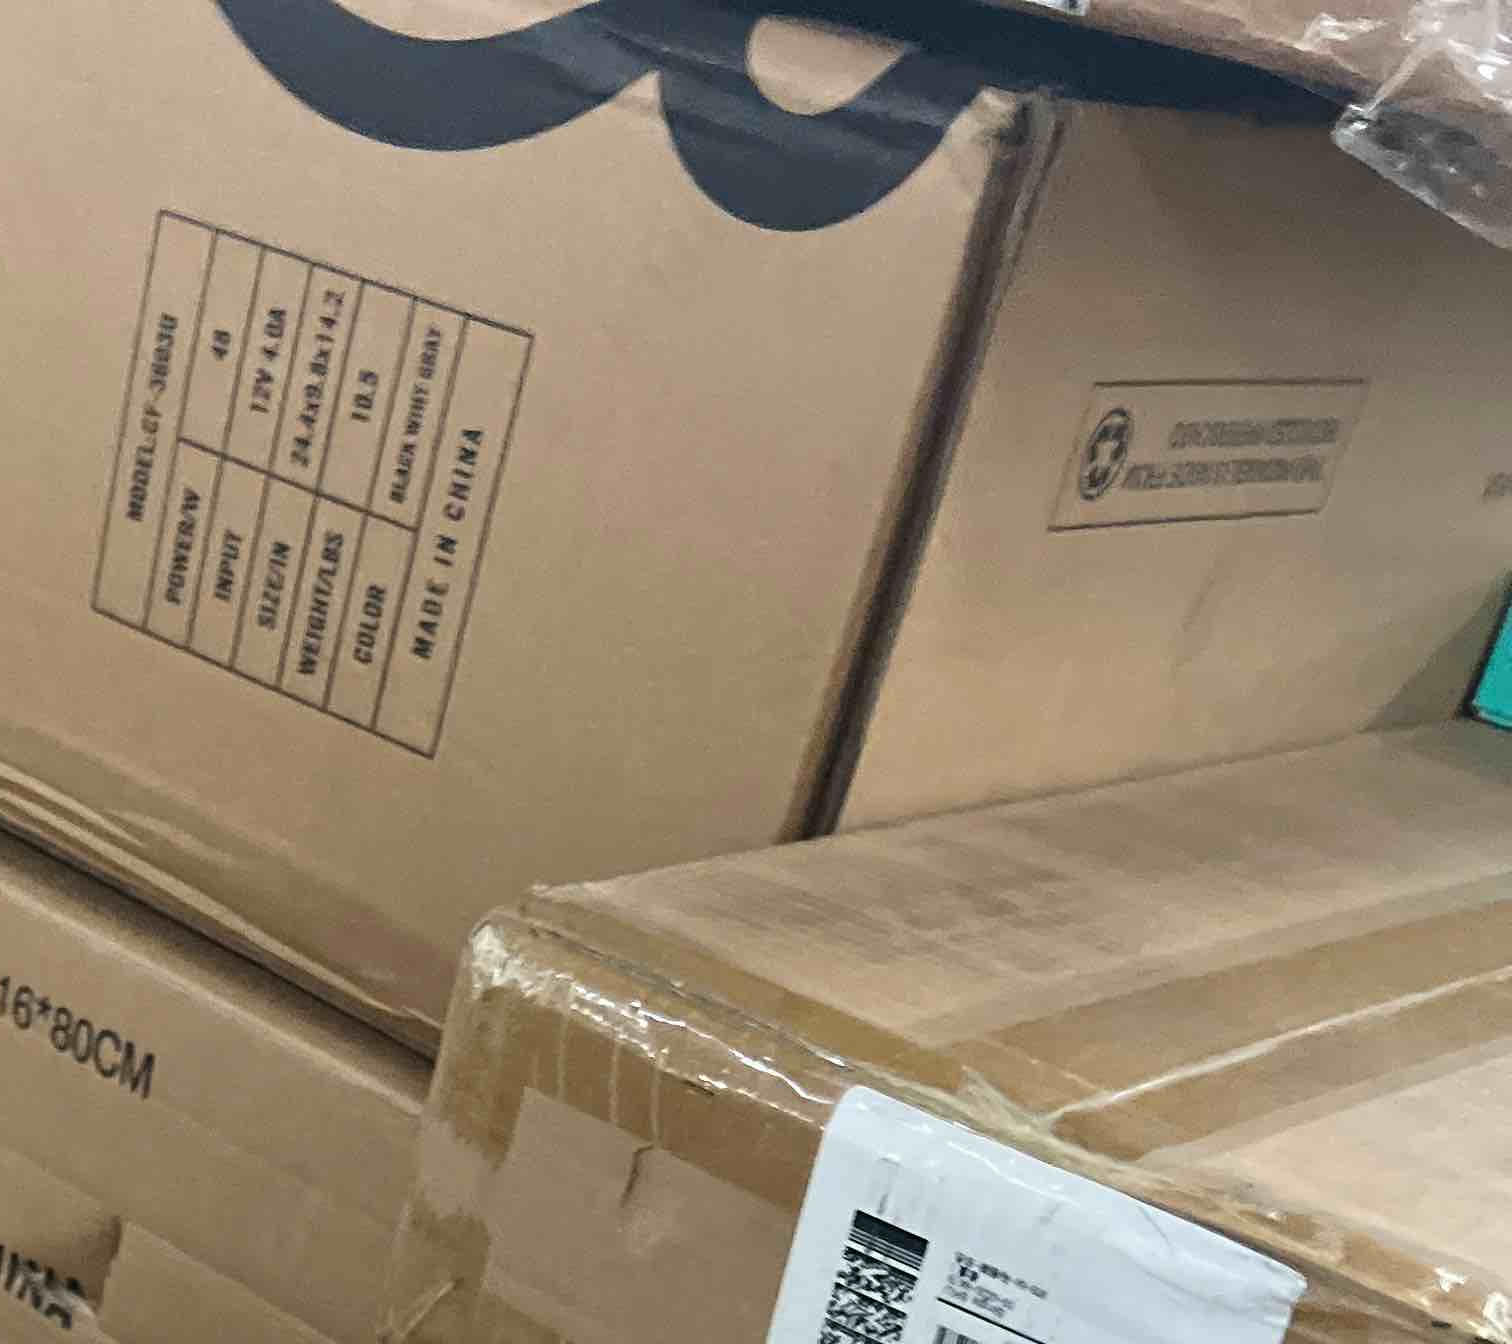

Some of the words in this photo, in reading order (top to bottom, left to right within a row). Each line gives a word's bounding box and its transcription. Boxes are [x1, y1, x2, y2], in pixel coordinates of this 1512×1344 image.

[208, 326, 232, 362] 48
[258, 304, 288, 364] 4.0A
[248, 366, 276, 416] 12V
[388, 439, 416, 505] BLACK
[415, 325, 442, 381] GRAY
[441, 423, 484, 524] CHINA
[163, 486, 201, 606] POWER/W
[212, 527, 243, 604] INPUT
[256, 538, 291, 631] SIZE/IN
[431, 532, 457, 568] IN
[295, 527, 345, 680] WEIGHT/LBS
[351, 581, 387, 666] COLOR
[410, 575, 449, 661] MADE
